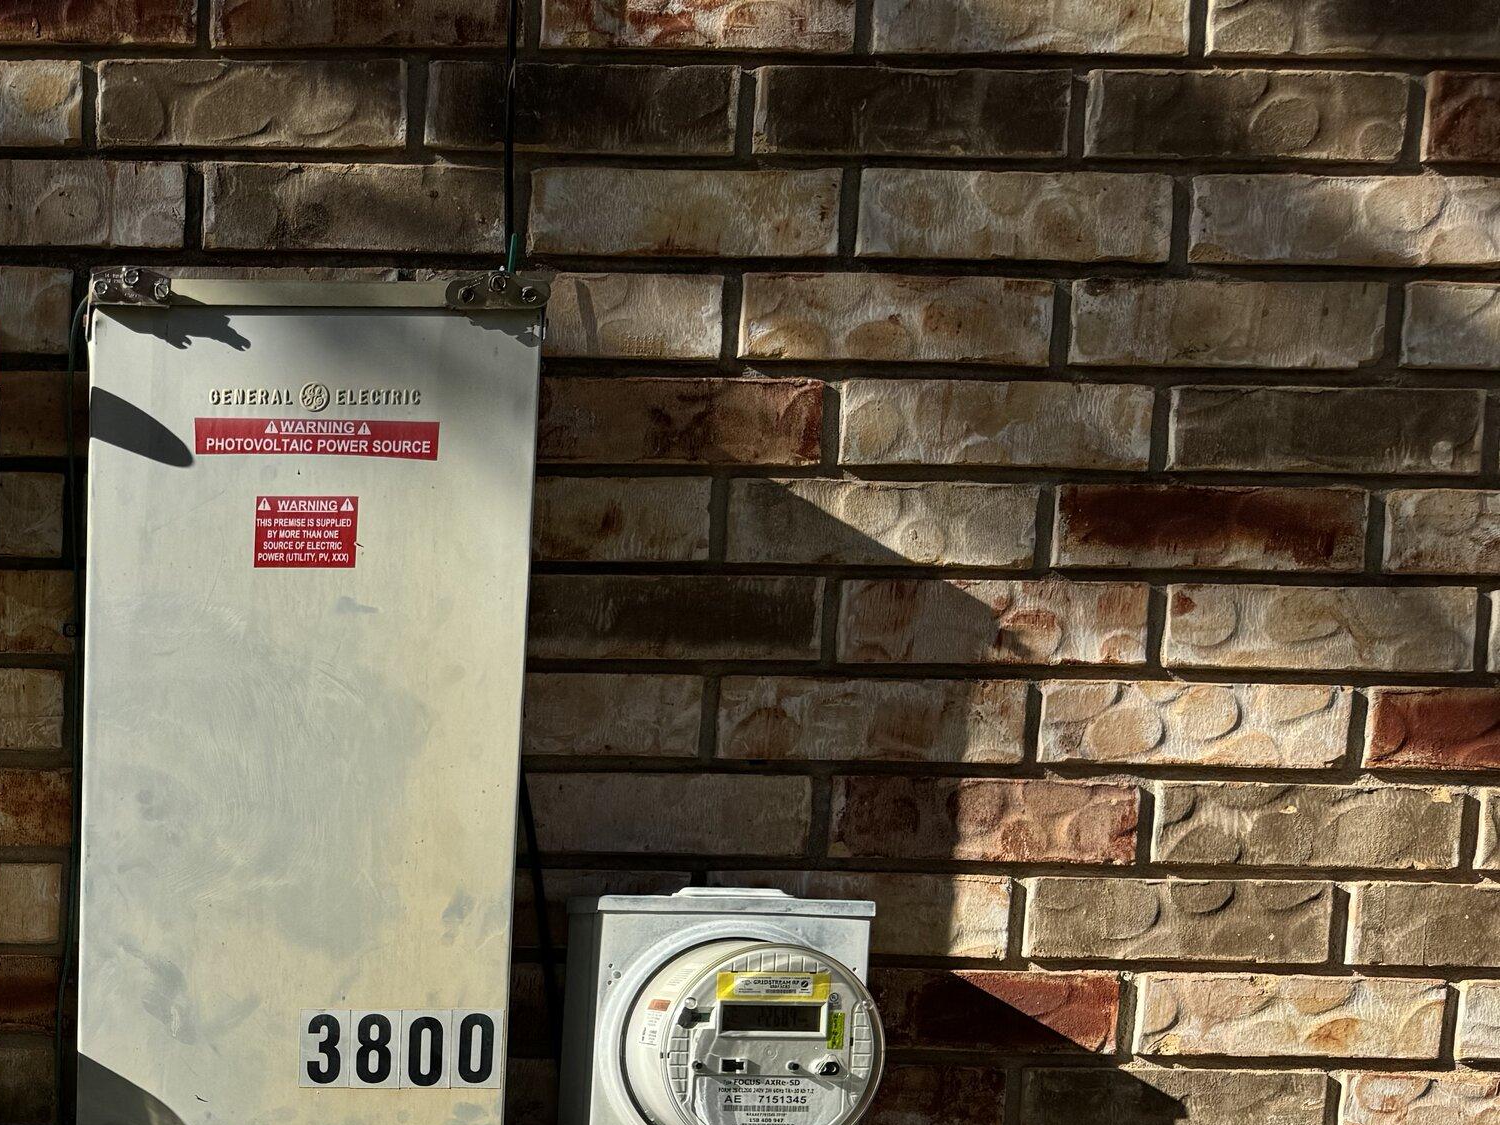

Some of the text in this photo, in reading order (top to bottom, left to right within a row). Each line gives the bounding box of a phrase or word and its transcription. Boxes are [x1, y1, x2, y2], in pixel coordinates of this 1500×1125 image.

[208, 388, 294, 406] GENERAL
[336, 388, 422, 406] ELECTRIC
[279, 420, 355, 435] WARNING
[206, 437, 431, 454] PHOTOVOLTAIC POWER SOURCE
[277, 500, 338, 513] WARNING
[257, 518, 352, 527] THIS PREMISE IS SUPPLIED
[267, 530, 339, 539] BY MORE THAN ONE
[263, 541, 342, 550] SOURCE OF ELECTRIC
[257, 552, 285, 561] POWER
[307, 1012, 494, 1087] 3800
[733, 1078, 761, 1086] FOCUS
[724, 1095, 807, 1104] AE 7151345
